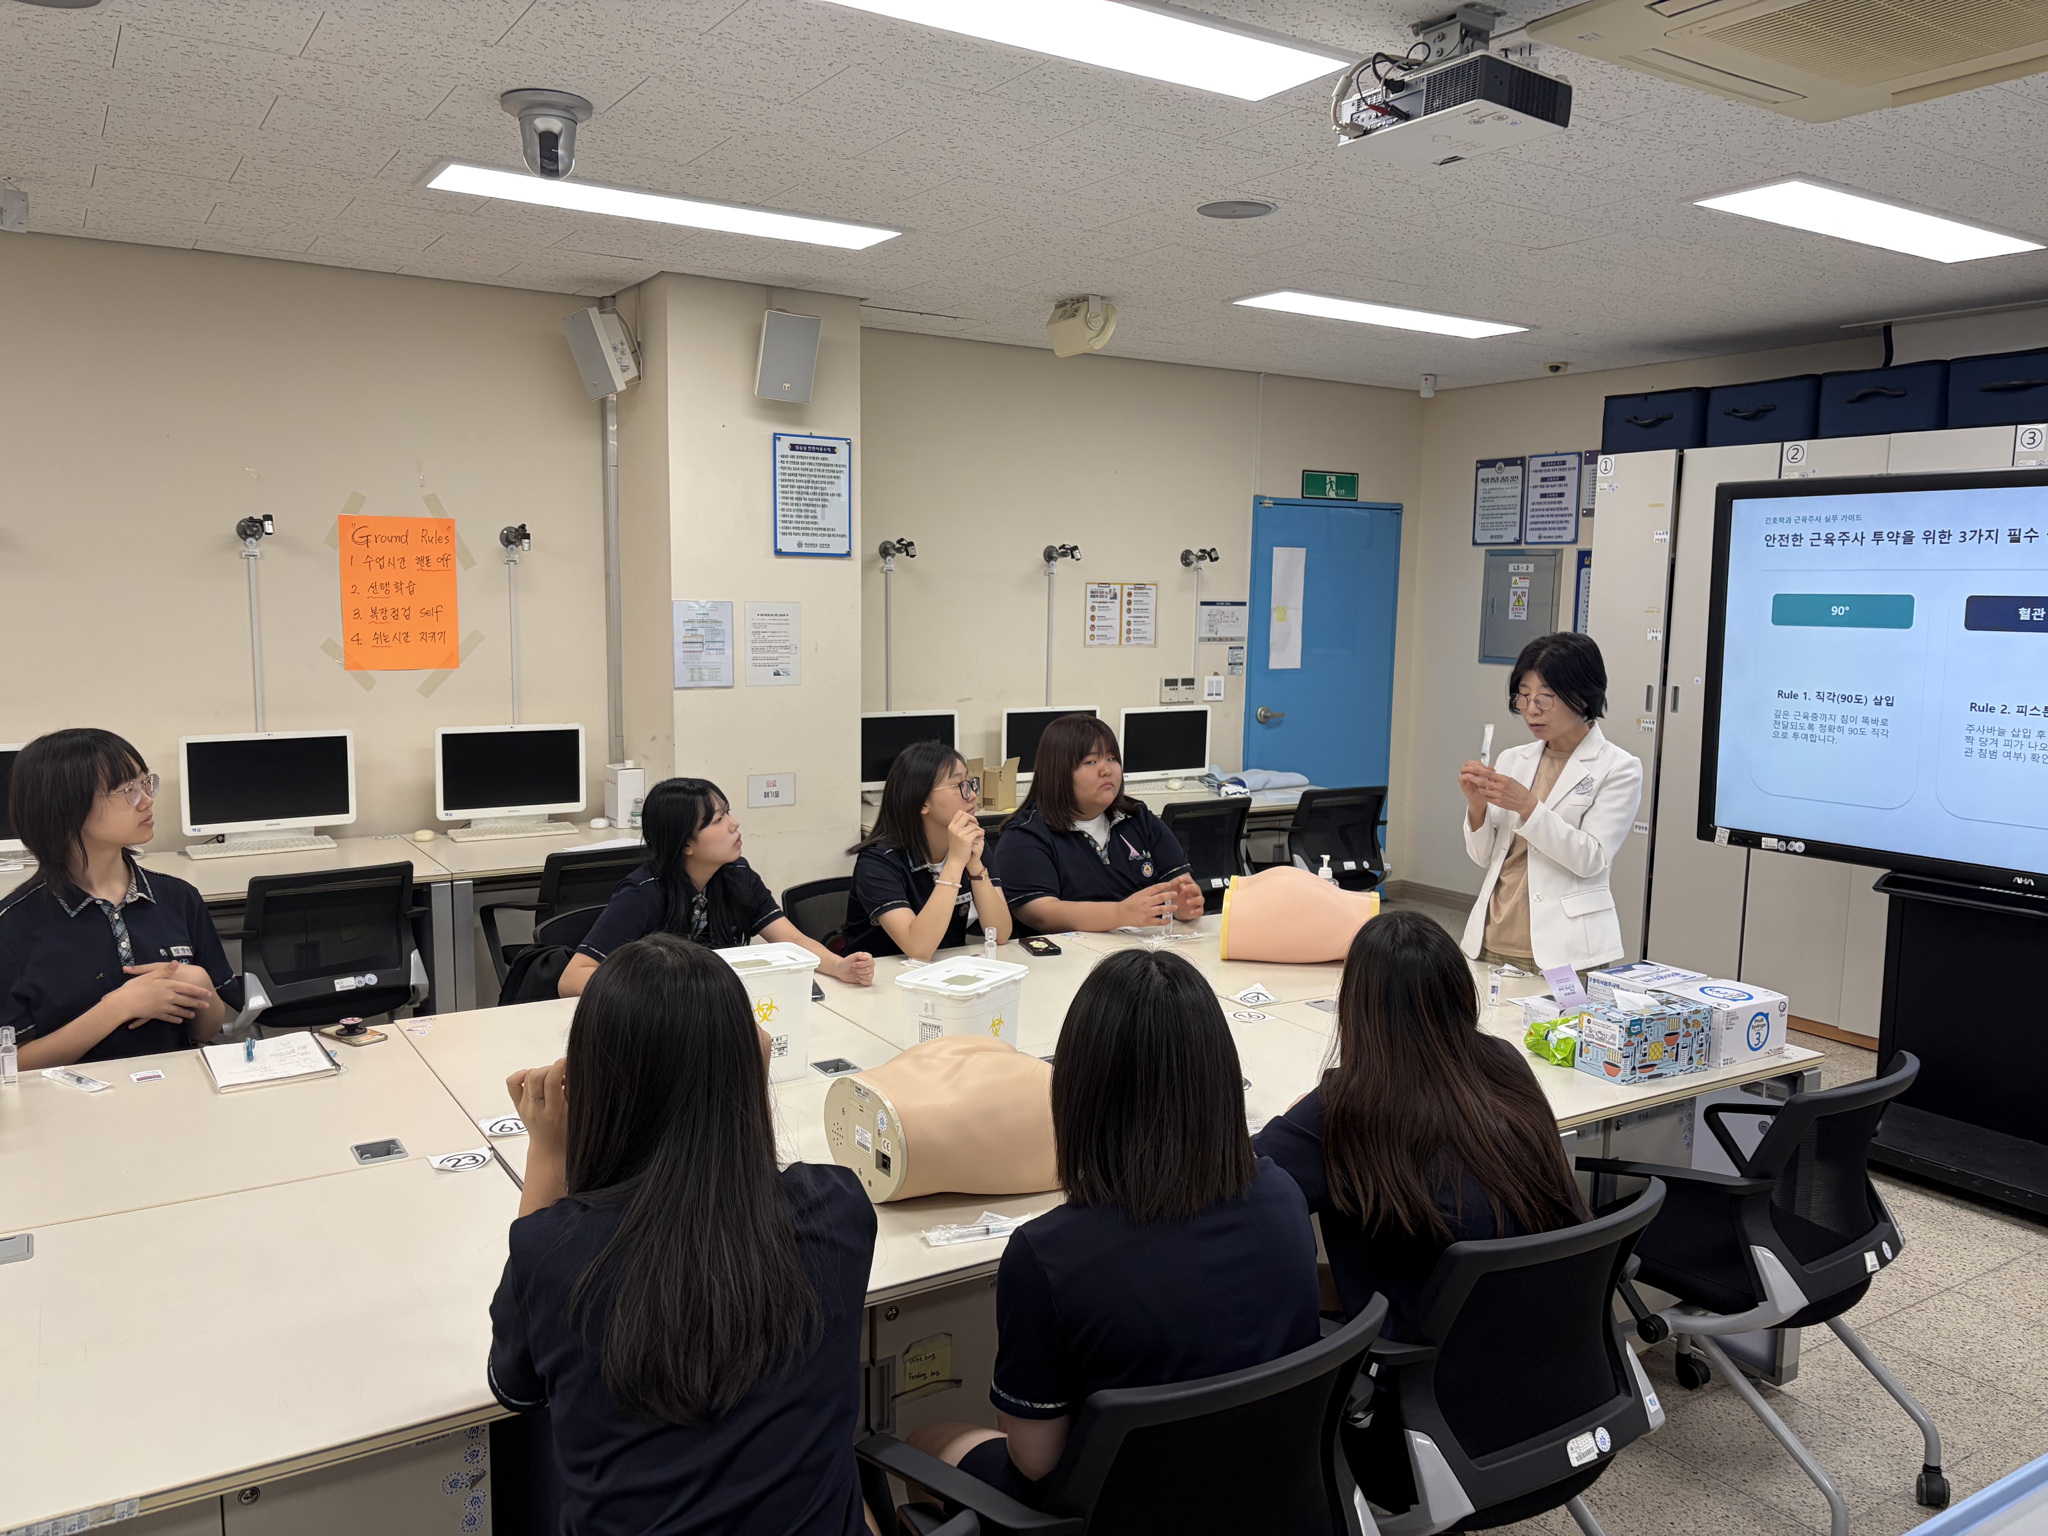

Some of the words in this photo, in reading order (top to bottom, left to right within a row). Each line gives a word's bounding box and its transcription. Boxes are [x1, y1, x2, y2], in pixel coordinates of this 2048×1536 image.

[1765, 516, 1792, 525] 간호학과
[1794, 515, 1822, 524] 근육주사
[1824, 515, 1838, 523] 실무
[1840, 514, 1862, 523] 가이드
[1764, 532, 1804, 548] 안전한
[1809, 531, 1866, 547] 근육주사
[1871, 529, 1916, 546] 투약을
[1921, 529, 1953, 545] 위한
[1958, 528, 1999, 545] 3가지
[2007, 527, 2040, 544] 필수
[363, 555, 407, 571] 수업시간
[350, 584, 360, 595] 2.
[352, 608, 362, 620] 3.
[1830, 605, 1850, 616] 90°
[2018, 606, 2046, 622] 혈관
[350, 633, 363, 646] 4.
[419, 631, 446, 645] 지키기
[1777, 690, 1799, 700] Rule
[1802, 691, 1811, 701] 1.
[1815, 691, 1868, 706] 직각(90도)
[1872, 695, 1895, 707] 삽입
[1969, 702, 1996, 714] Rule
[2000, 704, 2011, 715] 2.
[1773, 709, 1790, 720] 깊은
[1793, 710, 1837, 723] 근육층까지
[1840, 714, 1858, 725] 침이
[1861, 716, 1889, 727] 똑바로
[1772, 720, 1815, 732] 전달되도록
[1818, 723, 1845, 735] 정확히
[1847, 727, 1867, 736] 90도
[1870, 728, 1890, 739] 직각
[1965, 723, 2007, 737] 주사바늘
[2010, 727, 2032, 739] 삽입
[2035, 729, 2046, 740] 후
[1772, 731, 1789, 740] 으로
[1792, 732, 1838, 745] 투여합니다.
[1964, 735, 1975, 746] 짝
[1978, 736, 1999, 748] 당겨
[2002, 738, 2024, 750] 피가
[1963, 747, 1974, 758] 관
[1977, 748, 1998, 760] 침범
[2002, 750, 2027, 763] 여부)
[765, 780, 777, 788] 의료
[763, 790, 780, 798] 폐기물
[446, 1155, 480, 1168] 23
